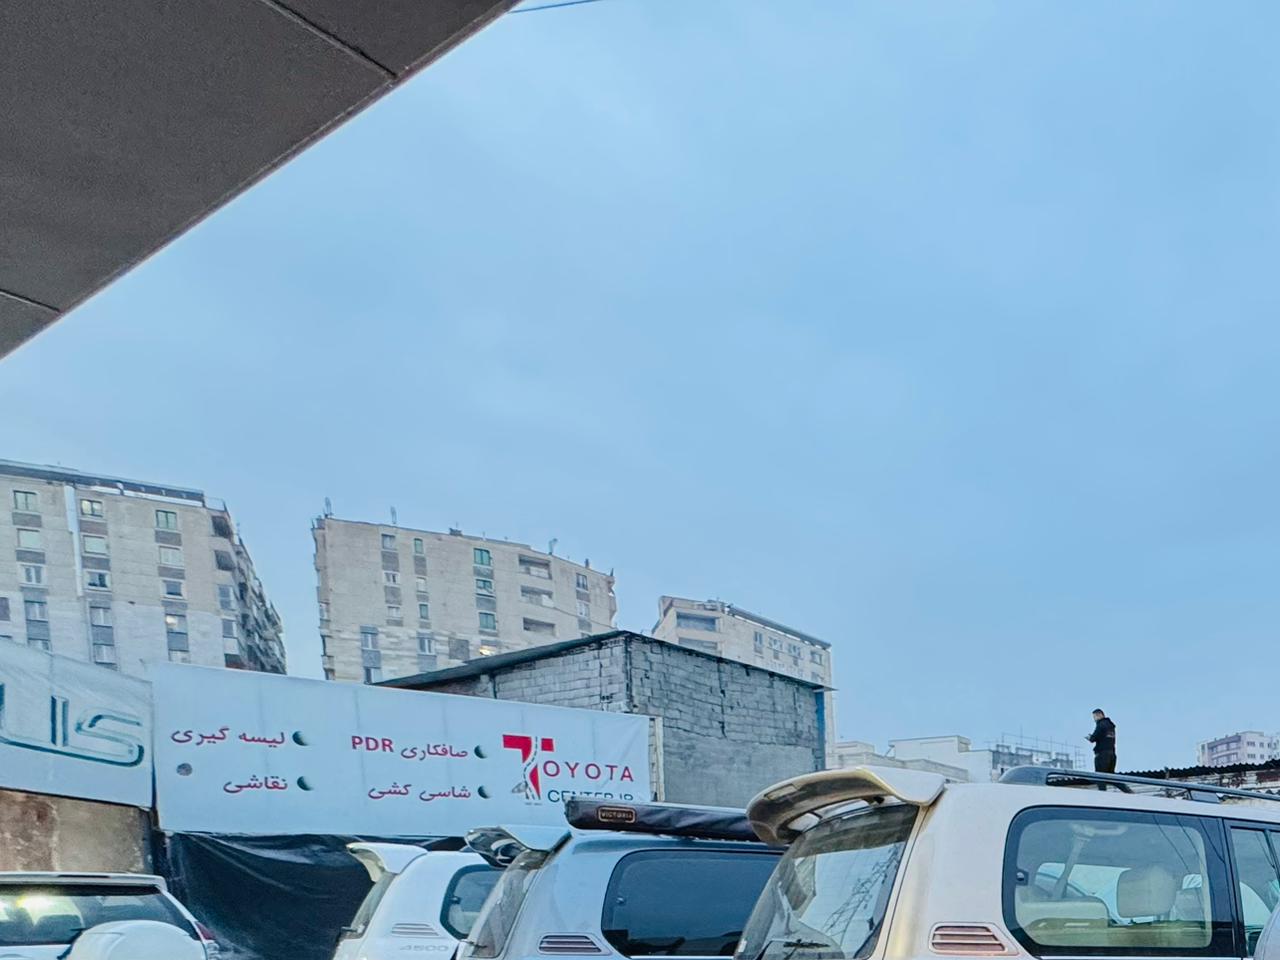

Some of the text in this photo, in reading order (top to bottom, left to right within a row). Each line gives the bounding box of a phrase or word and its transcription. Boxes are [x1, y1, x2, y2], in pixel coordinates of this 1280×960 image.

[170, 724, 285, 748] لیسه گیری
[351, 735, 468, 761] صافکاری PDR
[223, 774, 288, 793] نقاشی
[368, 782, 471, 801] شاسی کشی
